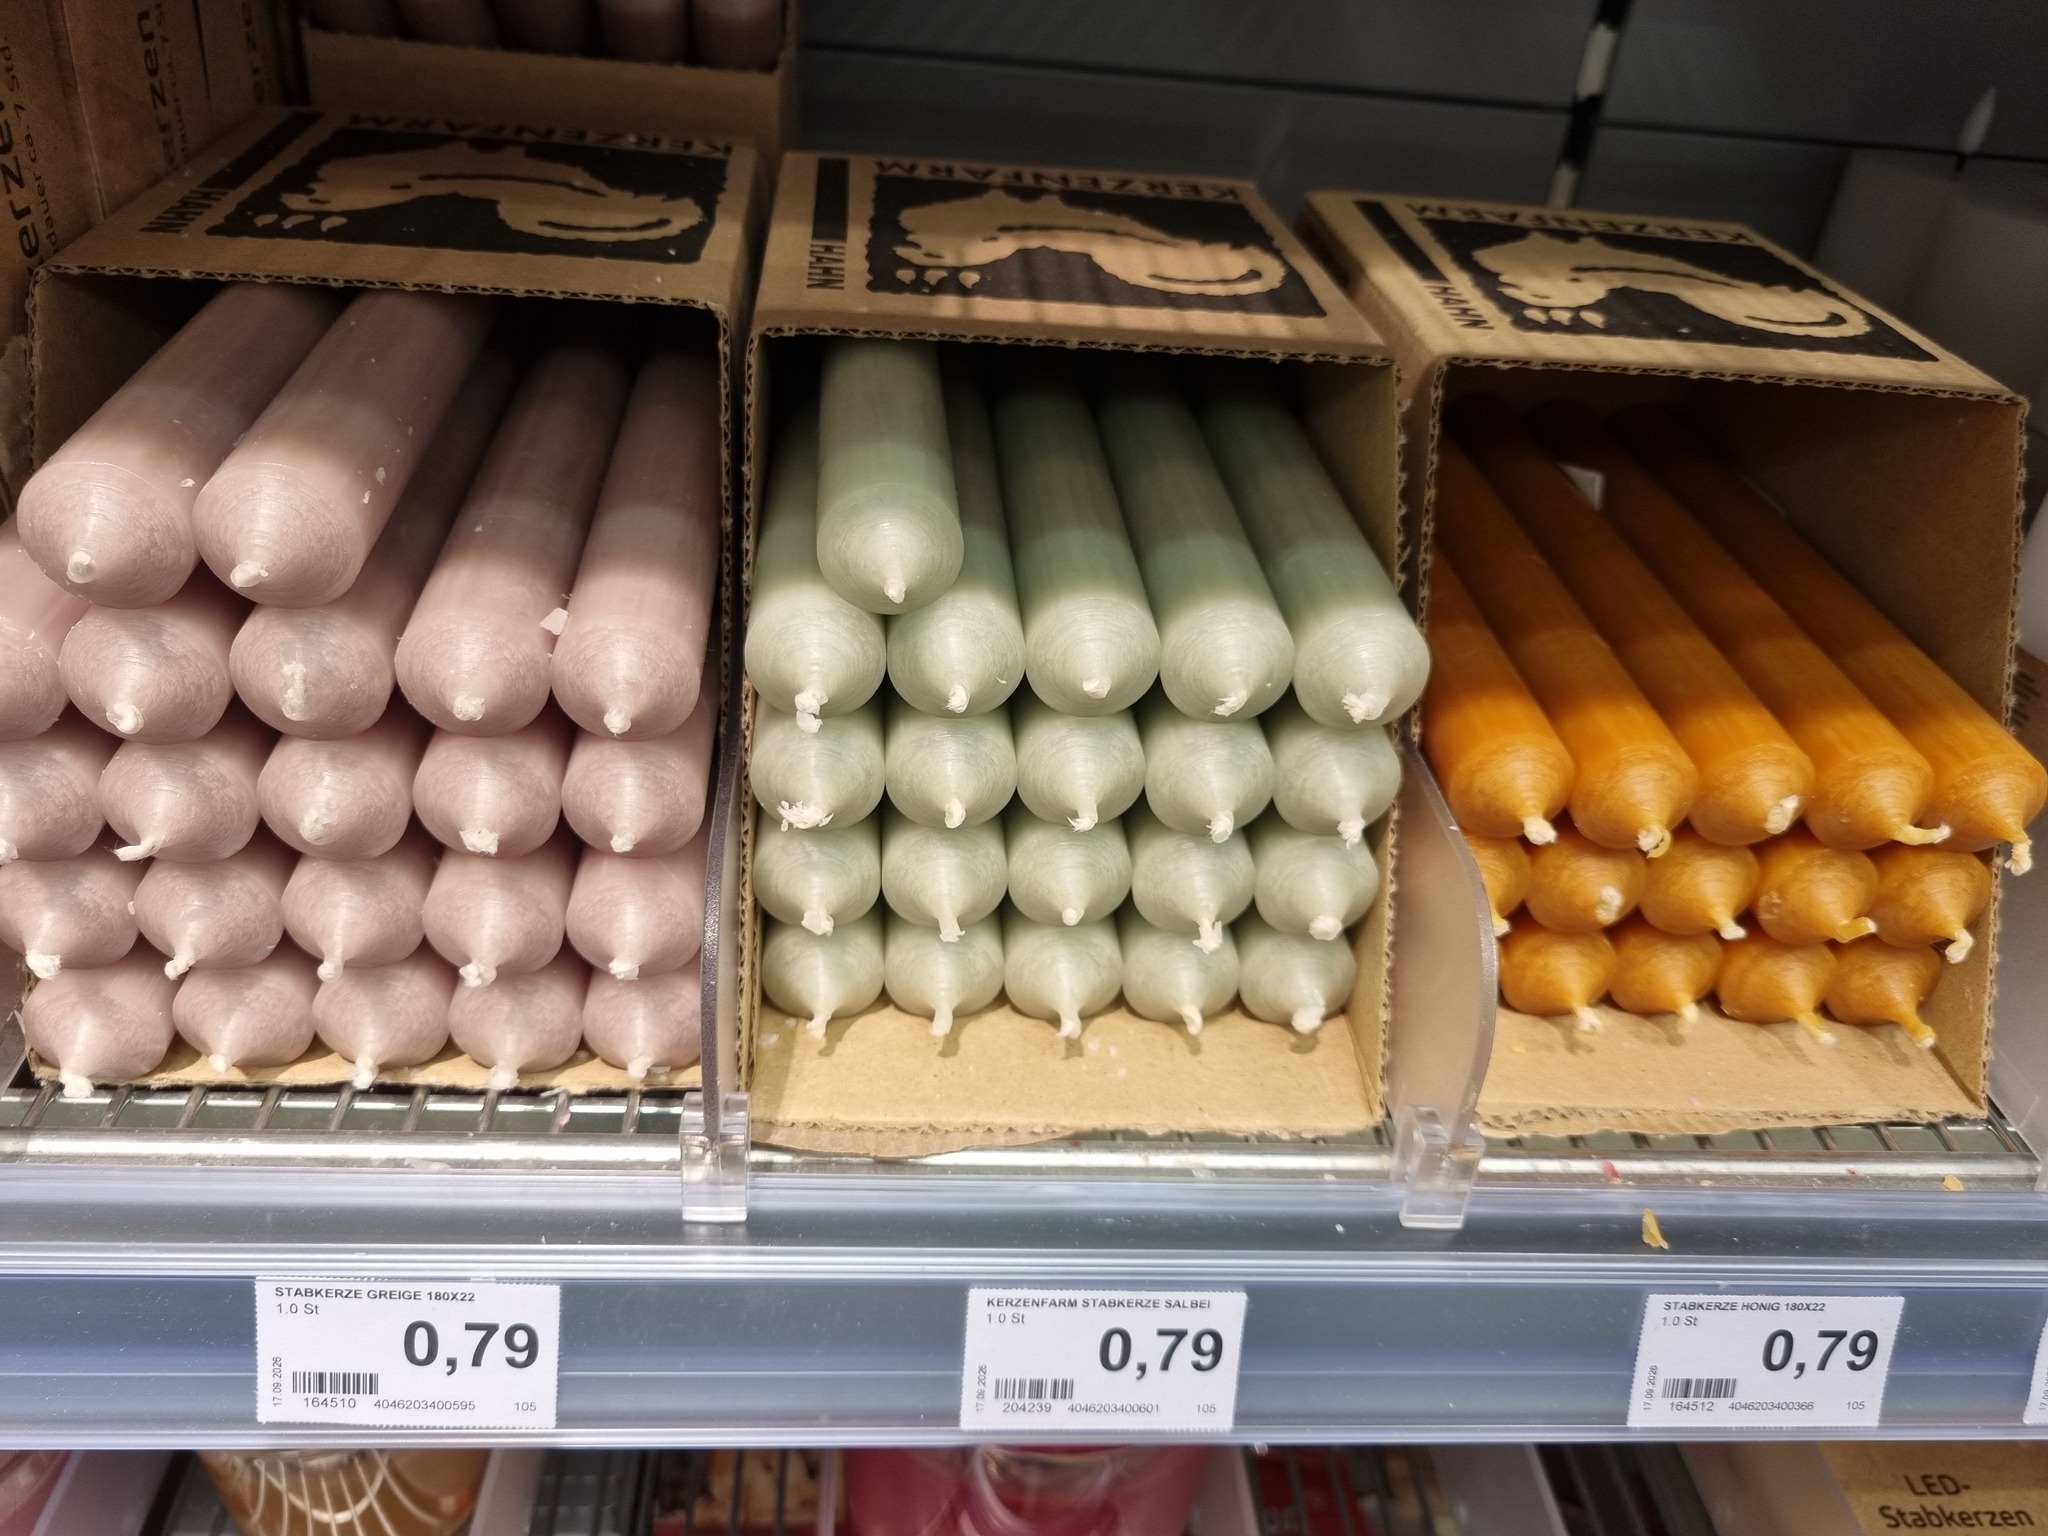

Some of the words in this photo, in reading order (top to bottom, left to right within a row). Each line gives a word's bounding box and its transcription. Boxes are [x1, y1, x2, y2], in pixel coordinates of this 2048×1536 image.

[1, 37, 20, 92] Std.
[13, 103, 25, 119] 7
[24, 126, 37, 163] ca.
[349, 113, 733, 155] KERZENFARM
[0, 101, 43, 276] erze
[874, 160, 1240, 201] KERZENFARM
[139, 189, 231, 233] HAHN
[1405, 203, 1752, 243] KERZENFARM
[806, 244, 845, 290] HAHN
[1423, 285, 1495, 330] HAHN
[275, 1286, 363, 1300] STABKERZE
[366, 1289, 422, 1301] GREIGE
[426, 1290, 476, 1302] 180X22
[276, 1303, 298, 1315] 1.0
[304, 1303, 320, 1315] St
[986, 1297, 1078, 1308] KERZENFARM
[1081, 1298, 1160, 1309] STABKERZE
[1164, 1298, 1211, 1309] SALBEI
[1663, 1301, 1737, 1311] STABKERZE
[1740, 1302, 1780, 1312] HONIG
[1785, 1302, 1826, 1312] 180X22
[987, 1313, 1006, 1324] 1.0
[1011, 1313, 1025, 1324] St
[1661, 1316, 1680, 1326] 1.0
[1683, 1316, 1698, 1327] St
[403, 1320, 540, 1377] 0,79
[1099, 1326, 1223, 1381] 0,79
[1761, 1328, 1879, 1380] 0,79
[272, 1356, 282, 1407] 17.09.2026
[975, 1364, 987, 1413] 17.09.2026
[1643, 1365, 1658, 1411] 17.09.2026
[303, 1397, 357, 1409] 164510
[373, 1399, 476, 1411] 4046203400595
[514, 1401, 537, 1412] 105
[1002, 1402, 1051, 1413] 204239
[1067, 1403, 1160, 1414] 4046203400601
[1196, 1403, 1217, 1413] 105
[1669, 1401, 1714, 1411] 164512
[1728, 1401, 1814, 1411] 4046203400366
[1846, 1402, 1865, 1411] 105
[1904, 1474, 1971, 1496] LED-
[1878, 1505, 2035, 1529] Stabkerzen
